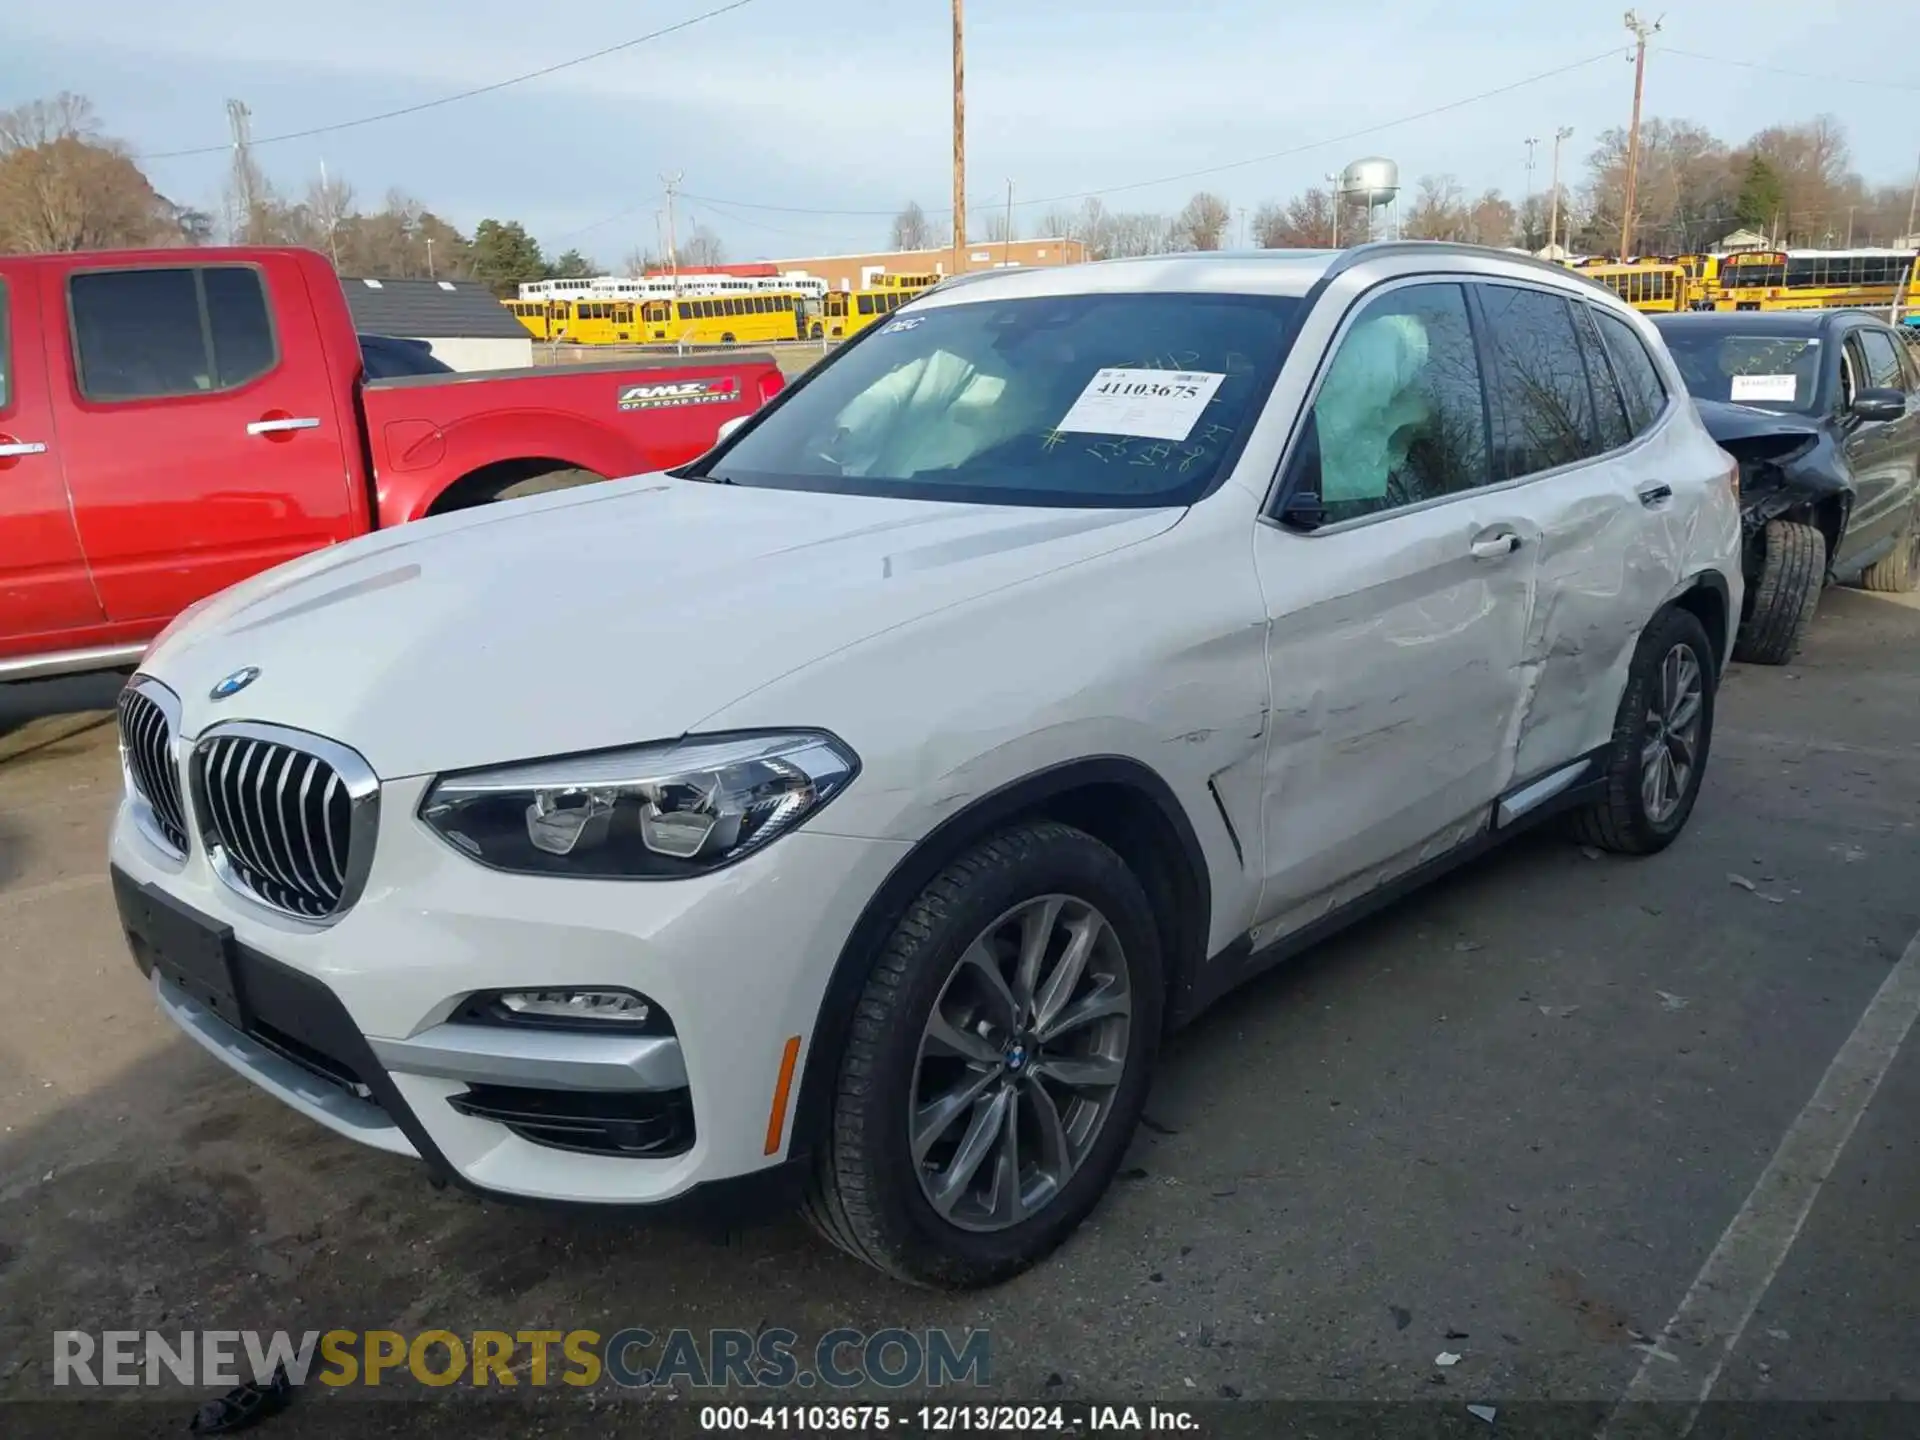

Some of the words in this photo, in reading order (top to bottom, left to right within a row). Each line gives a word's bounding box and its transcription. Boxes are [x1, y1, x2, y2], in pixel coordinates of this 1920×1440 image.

[1097, 382, 1200, 399] 41103675
[622, 401, 649, 410] OFF
[654, 398, 689, 407] ROAD
[694, 393, 736, 404] SPORT
